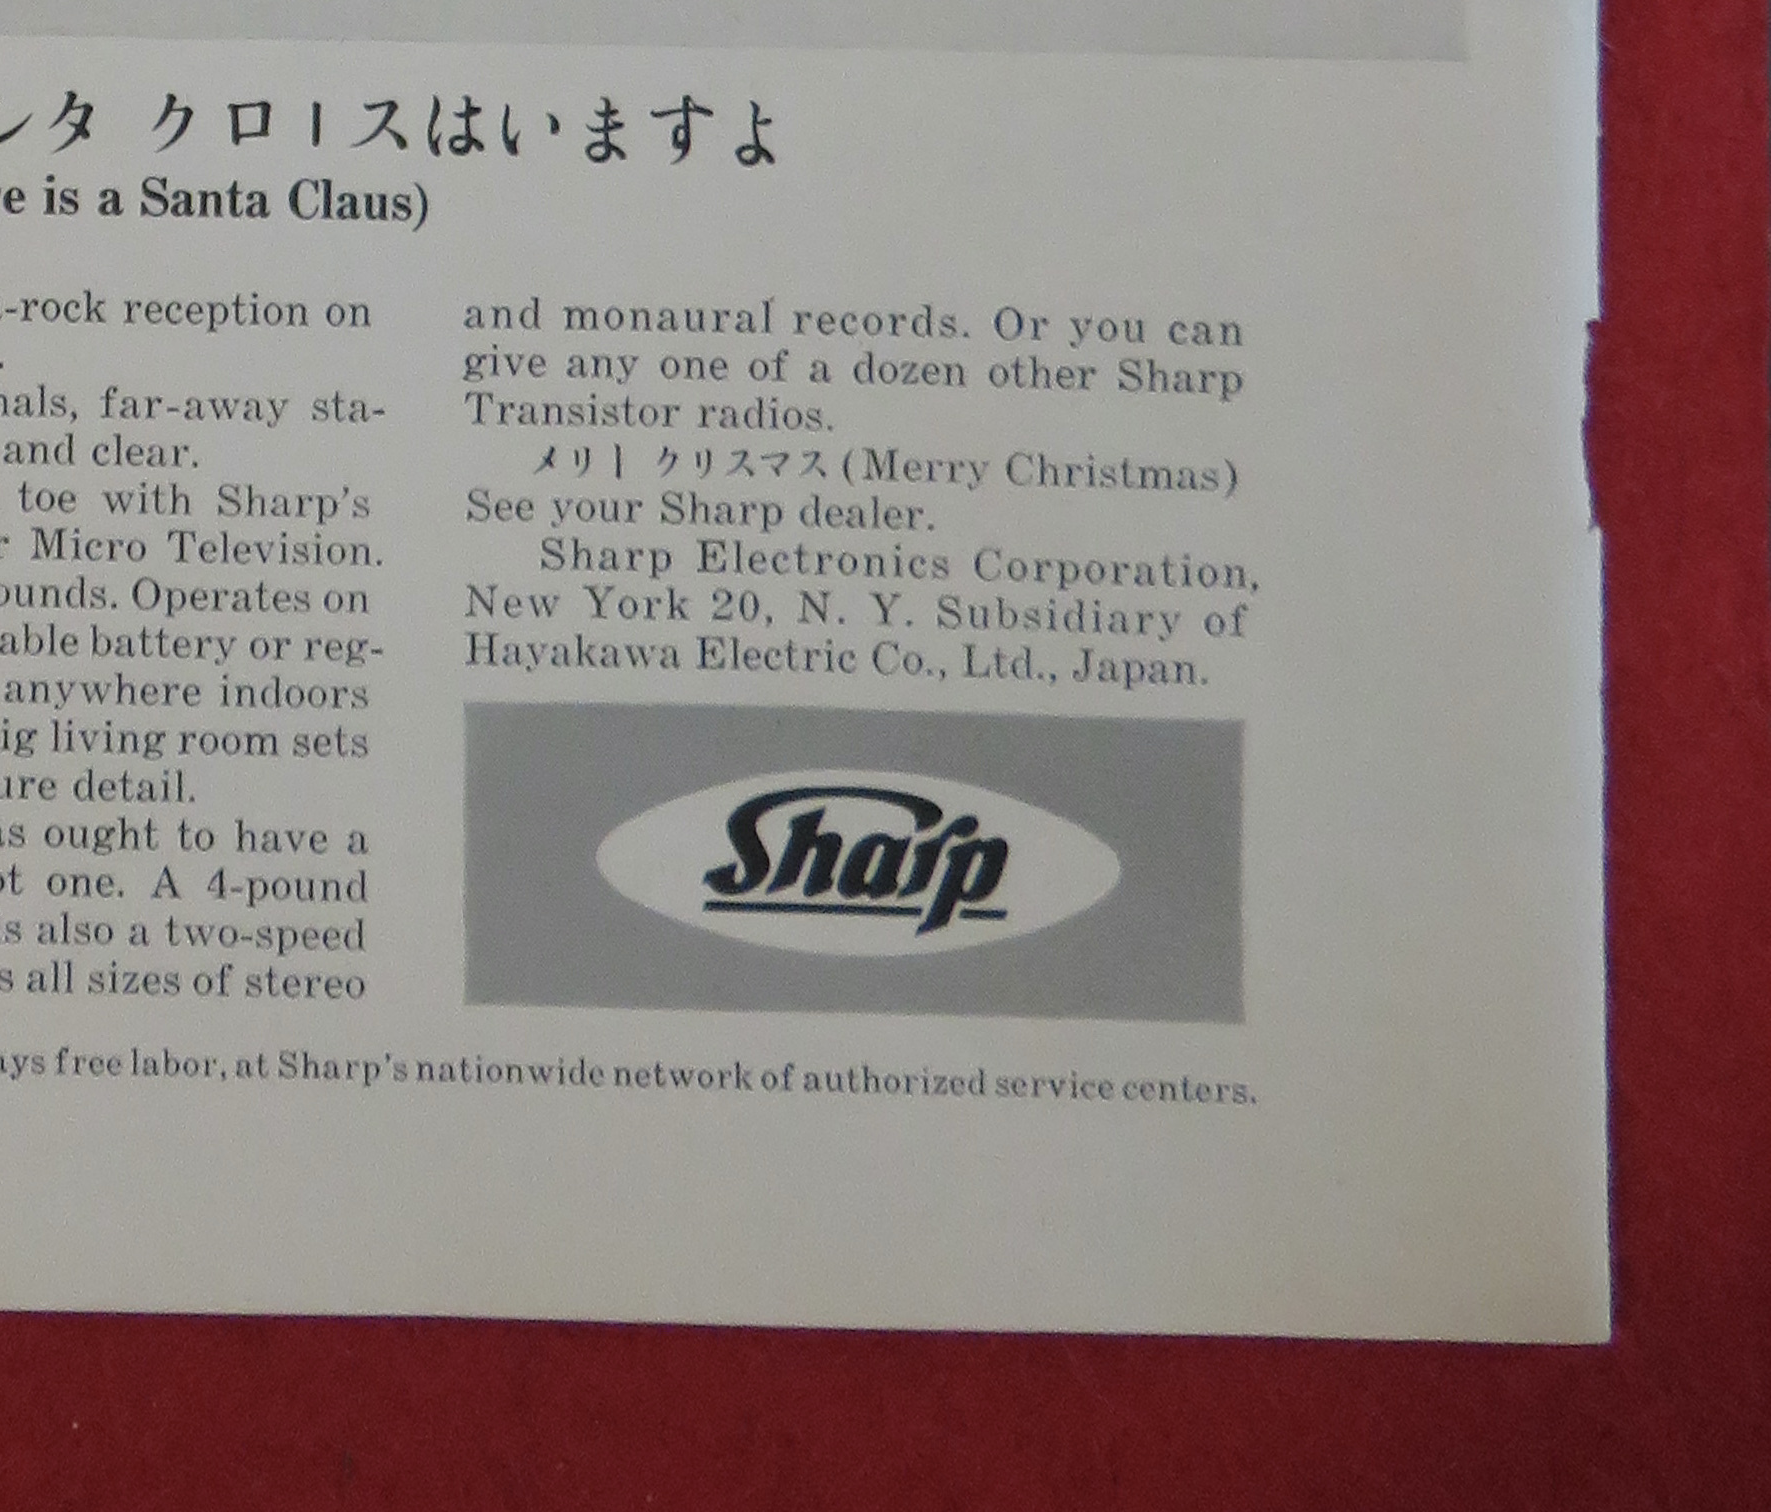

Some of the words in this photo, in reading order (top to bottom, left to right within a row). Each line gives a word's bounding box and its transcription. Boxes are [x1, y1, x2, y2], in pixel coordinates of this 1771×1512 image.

[44, 174, 79, 215] is
[98, 188, 124, 216] a
[140, 176, 271, 218] Santa
[289, 178, 428, 228] Claus)
[124, 292, 308, 332] reception
[326, 303, 371, 327] on
[464, 297, 540, 329] and
[563, 297, 774, 333] monaural
[794, 304, 969, 337] records.
[994, 306, 1049, 340] Or
[1070, 318, 1144, 348] you
[1169, 321, 1242, 346] can
[463, 344, 546, 382] give
[567, 355, 638, 384] any
[660, 356, 728, 381] one
[749, 349, 789, 381] of
[809, 360, 831, 383] a
[853, 351, 965, 386] dozen
[989, 356, 1096, 390] other
[1119, 359, 1243, 402] Sharp
[101, 386, 288, 428] far-away
[465, 391, 680, 427] Transistor
[698, 397, 832, 431] radios.
[842, 446, 990, 491] (Merry
[1006, 452, 1238, 497] Christmas)
[467, 488, 534, 522] See
[551, 499, 643, 528] your
[661, 491, 783, 533] Sharp
[800, 495, 934, 530] dealer.
[31, 527, 146, 561] Micro
[168, 530, 382, 566] Television.
[541, 537, 672, 579] Sharp
[697, 539, 949, 579] Electronics
[974, 549, 1258, 591] Corporation,
[132, 577, 310, 617] Operates
[324, 591, 368, 613] on
[465, 584, 559, 618] New
[583, 585, 688, 620] York
[712, 589, 772, 626] 20,
[798, 591, 844, 624] N.
[871, 593, 912, 626] Y.
[937, 595, 1180, 641] Subsidiary
[1205, 604, 1248, 636] of
[91, 624, 236, 665] battery
[250, 638, 291, 660] or
[466, 632, 680, 672] Hayakawa
[697, 636, 855, 673] Electric
[872, 641, 946, 680] Co.,
[964, 644, 1056, 683] Ltd.,
[1073, 648, 1207, 690] Japan.
[47, 873, 123, 898] one.
[151, 865, 181, 899] A
[207, 867, 367, 908] 4-pound
[703, 786, 1008, 936] Sharp
[56, 1047, 122, 1076] free
[132, 1047, 226, 1081] labor,
[236, 1054, 268, 1078] at
[279, 1051, 407, 1087] Sharp's
[417, 1055, 604, 1087] nationwide
[614, 1061, 752, 1090] network
[761, 1063, 795, 1091] of
[804, 1065, 985, 1095] authorized
[995, 1071, 1113, 1099] service
[1123, 1077, 1256, 1104] centers.
